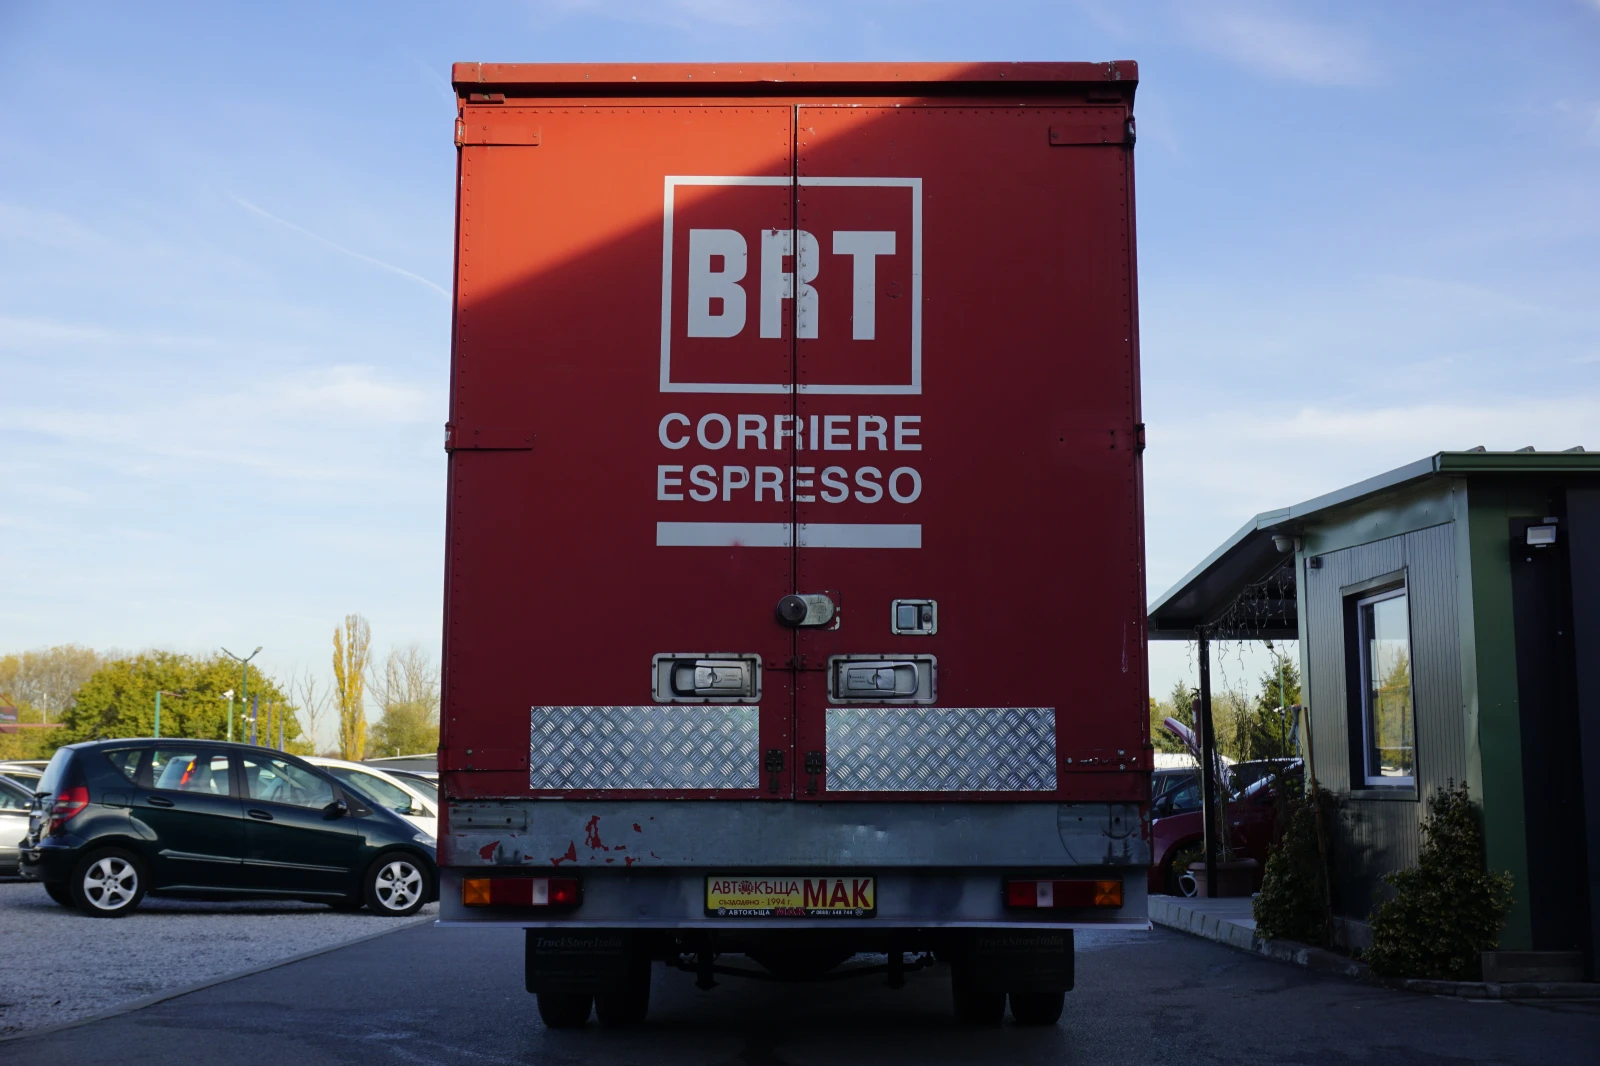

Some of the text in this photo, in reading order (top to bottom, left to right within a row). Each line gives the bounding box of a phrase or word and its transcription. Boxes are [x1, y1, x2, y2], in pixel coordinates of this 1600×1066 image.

[687, 228, 896, 341] BRT
[658, 412, 922, 451] CORRIERE
[656, 464, 922, 504] ESPRESSO
[767, 898, 786, 906] 1994
[803, 879, 871, 907] МАК
